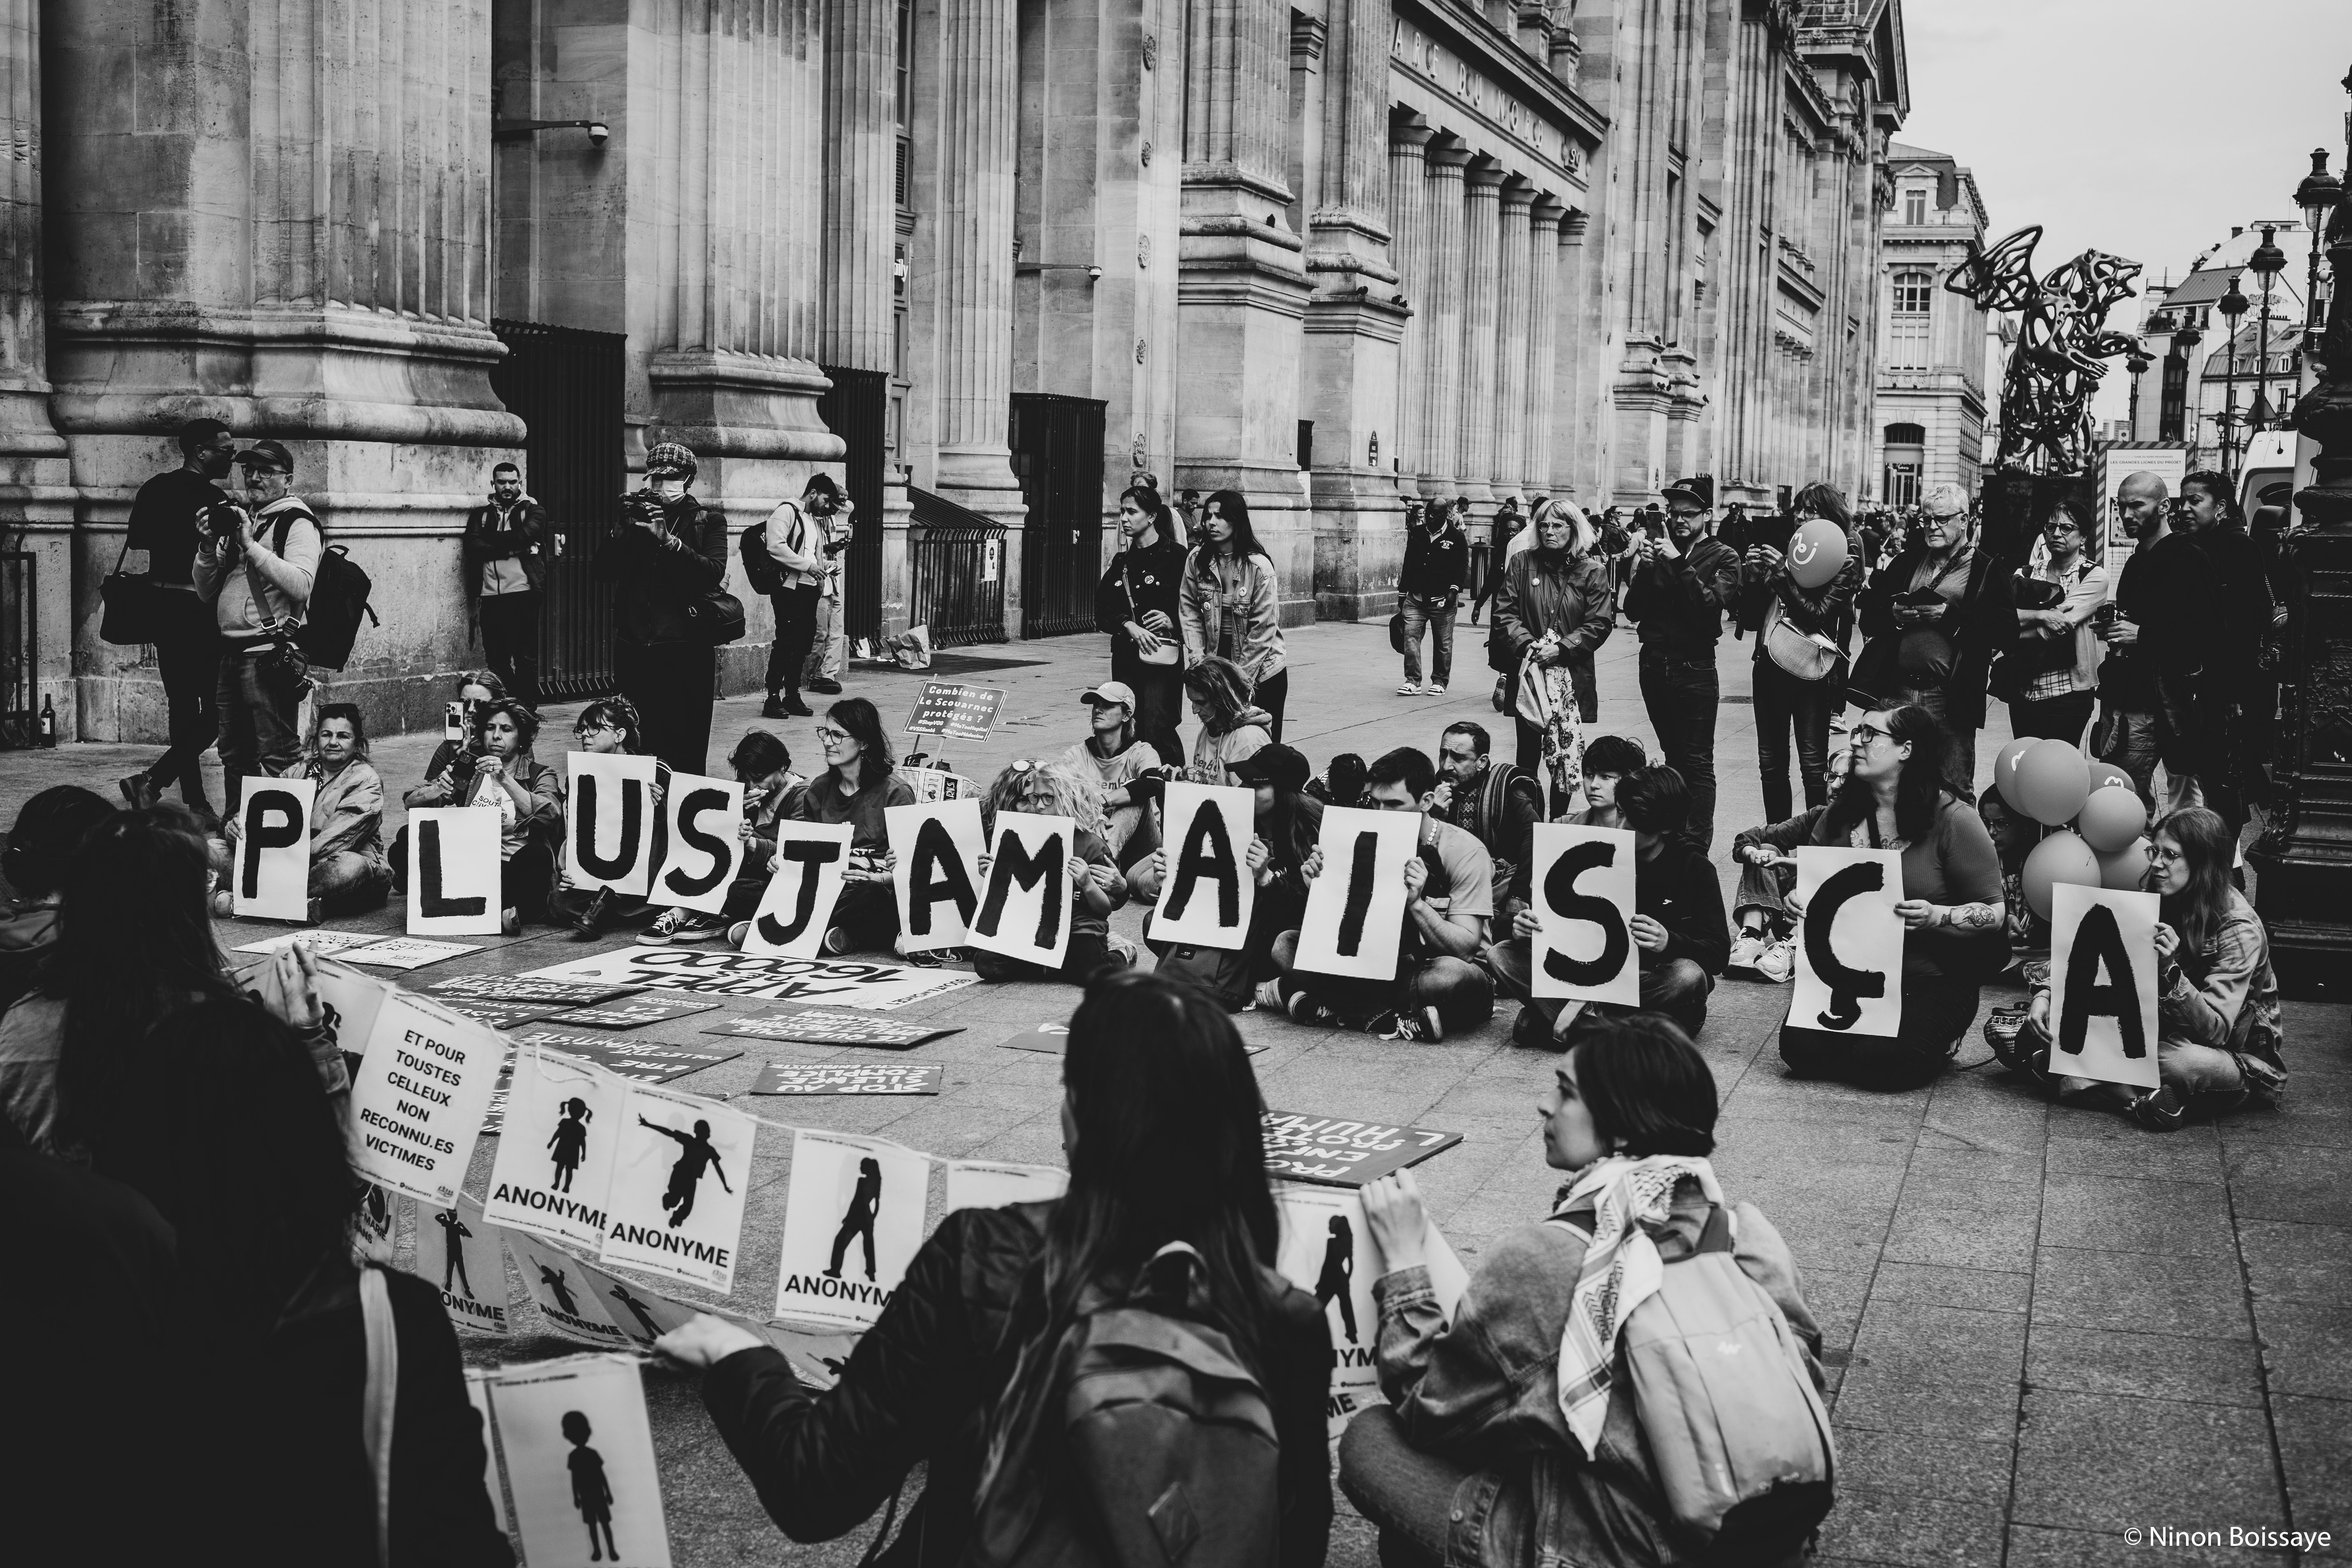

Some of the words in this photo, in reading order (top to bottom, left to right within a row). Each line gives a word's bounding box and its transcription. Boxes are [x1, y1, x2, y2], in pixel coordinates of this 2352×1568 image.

[1393, 18, 1439, 78] ARE
[1457, 63, 1483, 106] DU
[1496, 92, 1544, 148] NORD
[919, 697, 932, 706] Le
[935, 698, 993, 713] Scouarnec
[929, 686, 976, 700] Combien
[980, 691, 993, 701] de
[923, 710, 972, 722] protégés
[977, 715, 983, 723] ?
[242, 790, 303, 898] P
[576, 774, 641, 880] U
[665, 787, 732, 896] S
[419, 820, 487, 918] L
[909, 818, 978, 936] A
[1163, 799, 1240, 928] A
[756, 840, 842, 945] J
[975, 829, 1063, 950] M
[1337, 831, 1378, 957] I
[1543, 841, 1629, 987] S
[1804, 861, 1886, 1030] Ç
[619, 970, 862, 999] APPEL
[629, 952, 908, 983] 160000
[2059, 903, 2146, 1058] A
[550, 1014, 633, 1024] PLUS
[624, 1006, 671, 1015] ÇA
[404, 1030, 424, 1046] ET
[425, 1039, 466, 1065] POUR
[732, 1026, 805, 1037] VOUS
[838, 1027, 936, 1036] APPELEZ
[396, 1050, 461, 1086] TOUSTES
[609, 1060, 690, 1073] ÊTRE
[776, 1069, 929, 1078] COMPLICE
[781, 1075, 923, 1084] SILENCE
[388, 1072, 451, 1107] CELLEUX
[837, 1083, 929, 1093] STOP
[396, 1100, 430, 1122] NON
[360, 1108, 454, 1154] RECONNU.ES
[1261, 1113, 1445, 1146] L'HUMA
[366, 1134, 436, 1171] VICTIMES
[1263, 1160, 1351, 1178] PRO
[494, 1183, 606, 1231] ANONYME
[610, 1223, 730, 1268] ANONYME
[440, 1291, 505, 1321] ONYME
[785, 1274, 895, 1308] ANONYM
[539, 1302, 624, 1336] ANONYME
